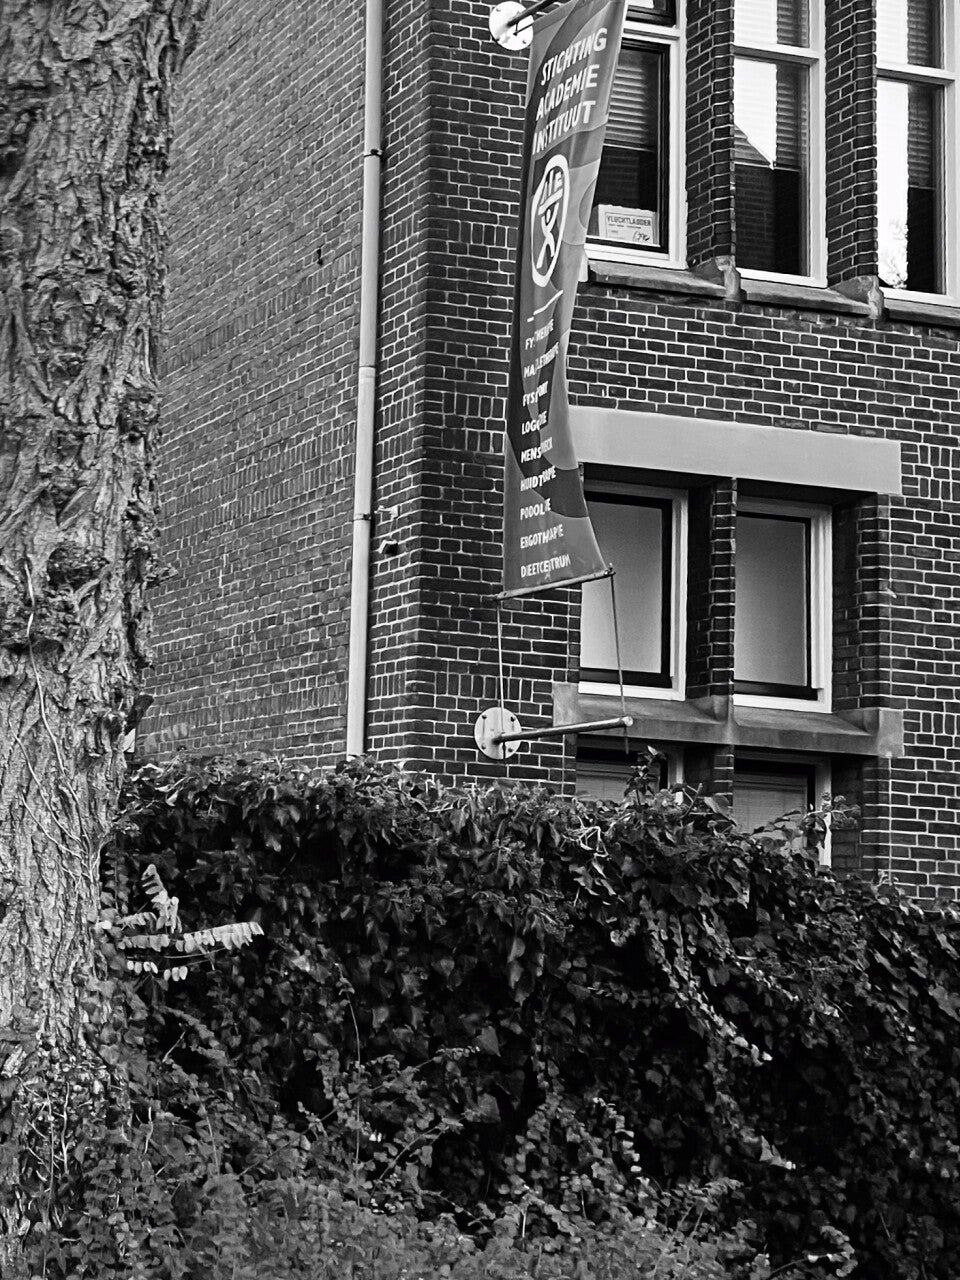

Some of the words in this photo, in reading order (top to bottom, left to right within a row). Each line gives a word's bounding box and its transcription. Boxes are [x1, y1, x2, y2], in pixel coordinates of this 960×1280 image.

[541, 27, 608, 86] STICHTING
[535, 64, 600, 121] ACADEMIE
[532, 100, 597, 155] INSTITUUT
